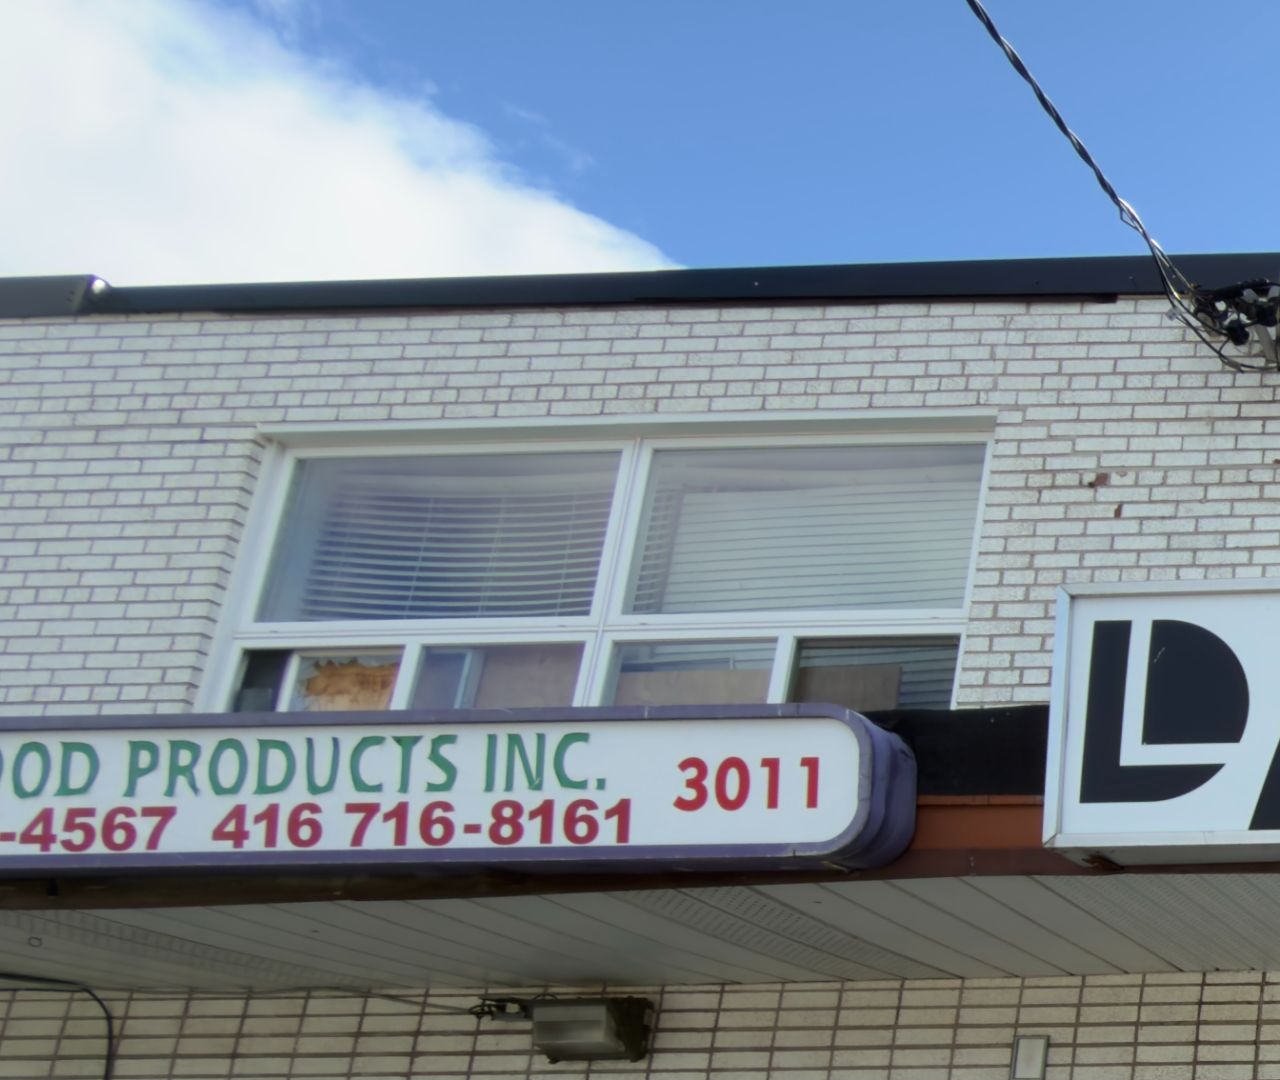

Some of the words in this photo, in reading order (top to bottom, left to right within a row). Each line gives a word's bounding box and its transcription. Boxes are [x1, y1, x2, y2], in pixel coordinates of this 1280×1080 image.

[0, 740, 100, 799] OD
[122, 732, 460, 798] PRODUCTS
[483, 732, 607, 794] INC.
[673, 756, 820, 813] 3011
[211, 802, 323, 849] 416
[344, 798, 633, 847] 716-8161
